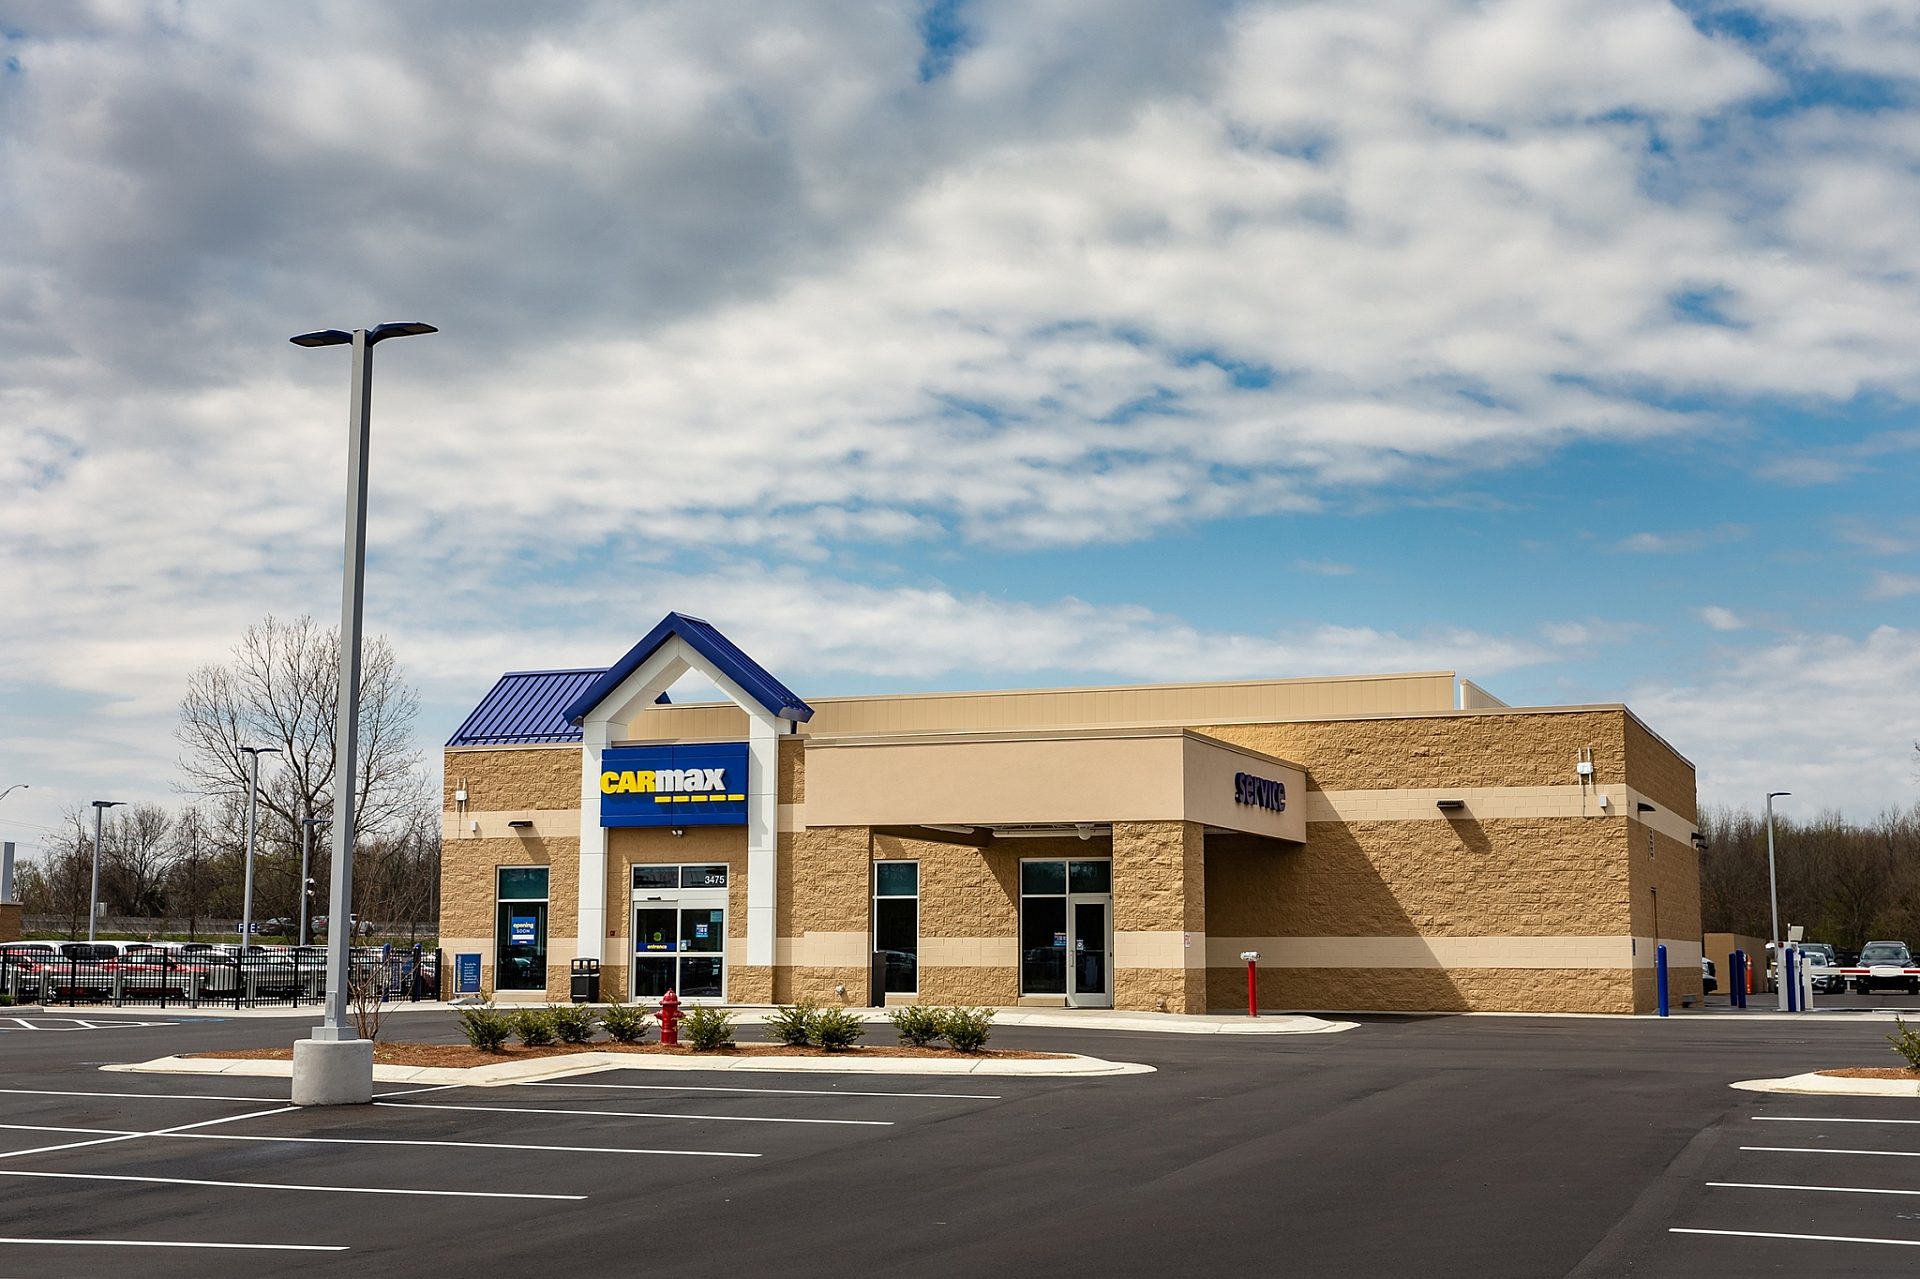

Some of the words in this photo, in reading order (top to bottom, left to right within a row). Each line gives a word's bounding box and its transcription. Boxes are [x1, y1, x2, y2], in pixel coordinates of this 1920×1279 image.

[600, 768, 726, 794] CARmax
[1235, 772, 1286, 812] service
[704, 875, 725, 884] 3475
[238, 923, 256, 933] FE
